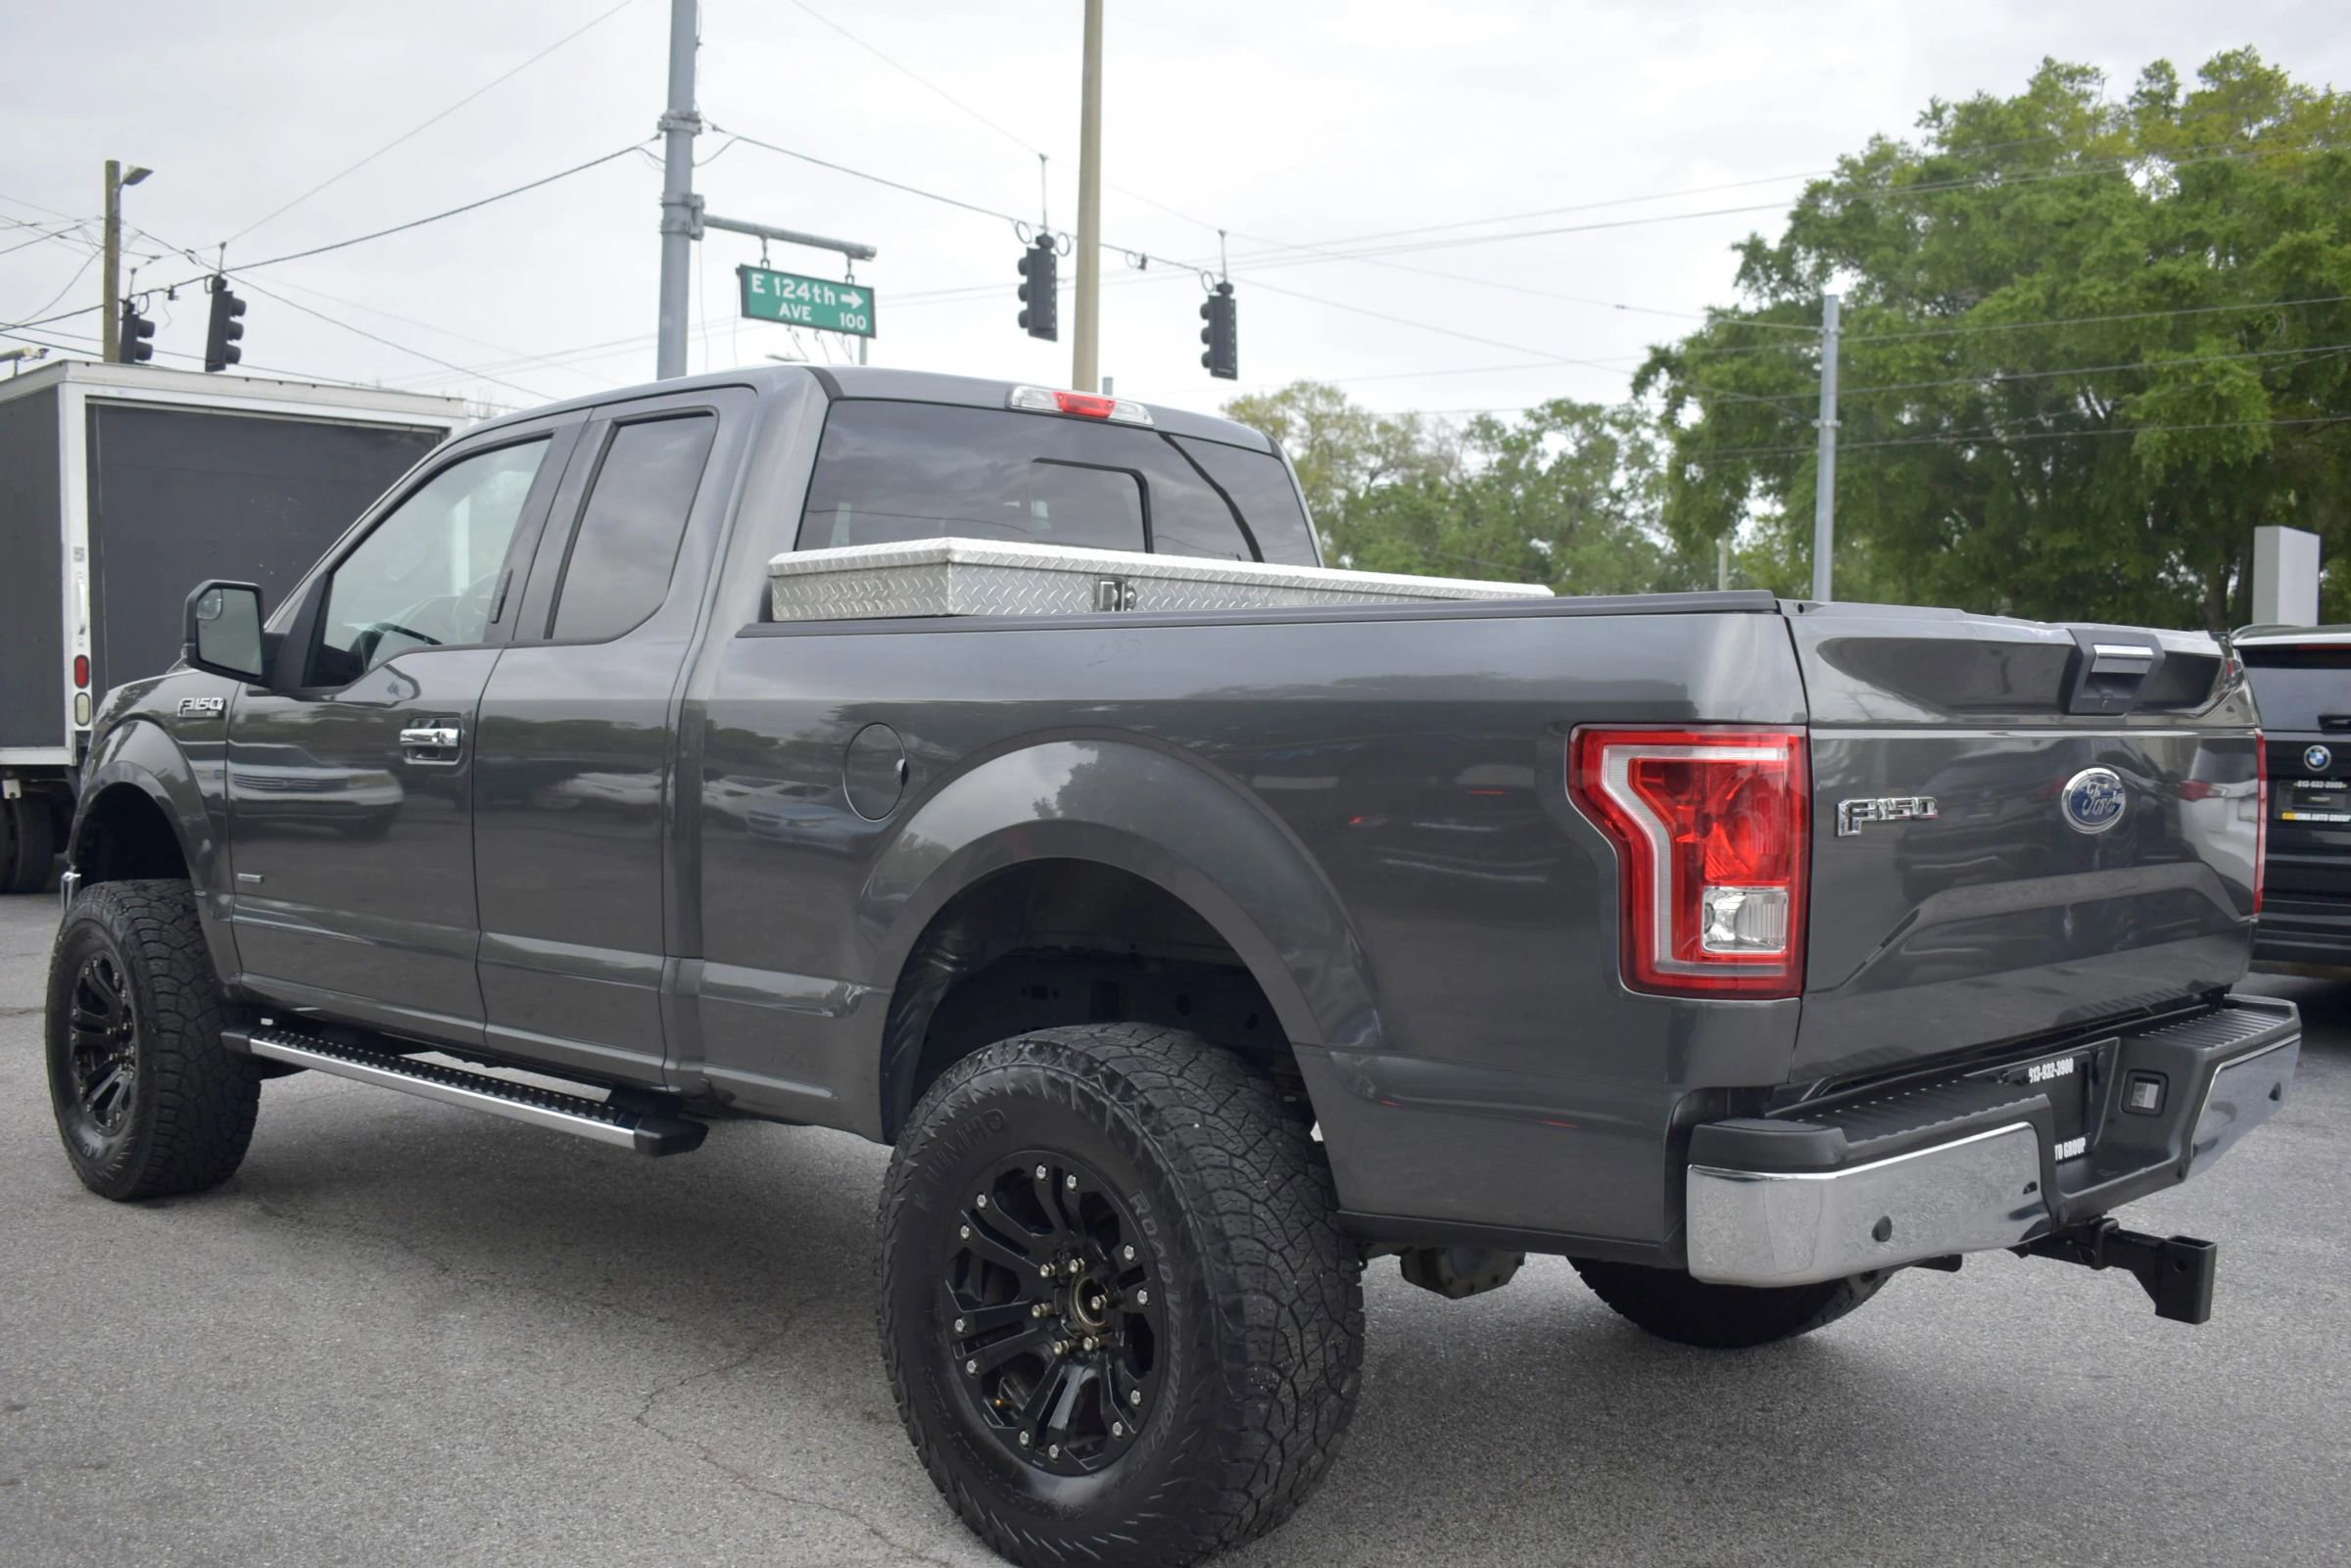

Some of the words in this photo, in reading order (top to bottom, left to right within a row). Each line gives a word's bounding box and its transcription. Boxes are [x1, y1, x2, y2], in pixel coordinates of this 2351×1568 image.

[751, 273, 765, 294] E
[772, 277, 836, 307] 124th
[779, 302, 812, 321] AVE
[840, 311, 867, 330] 100
[2063, 1137, 2086, 1159] GROUP
